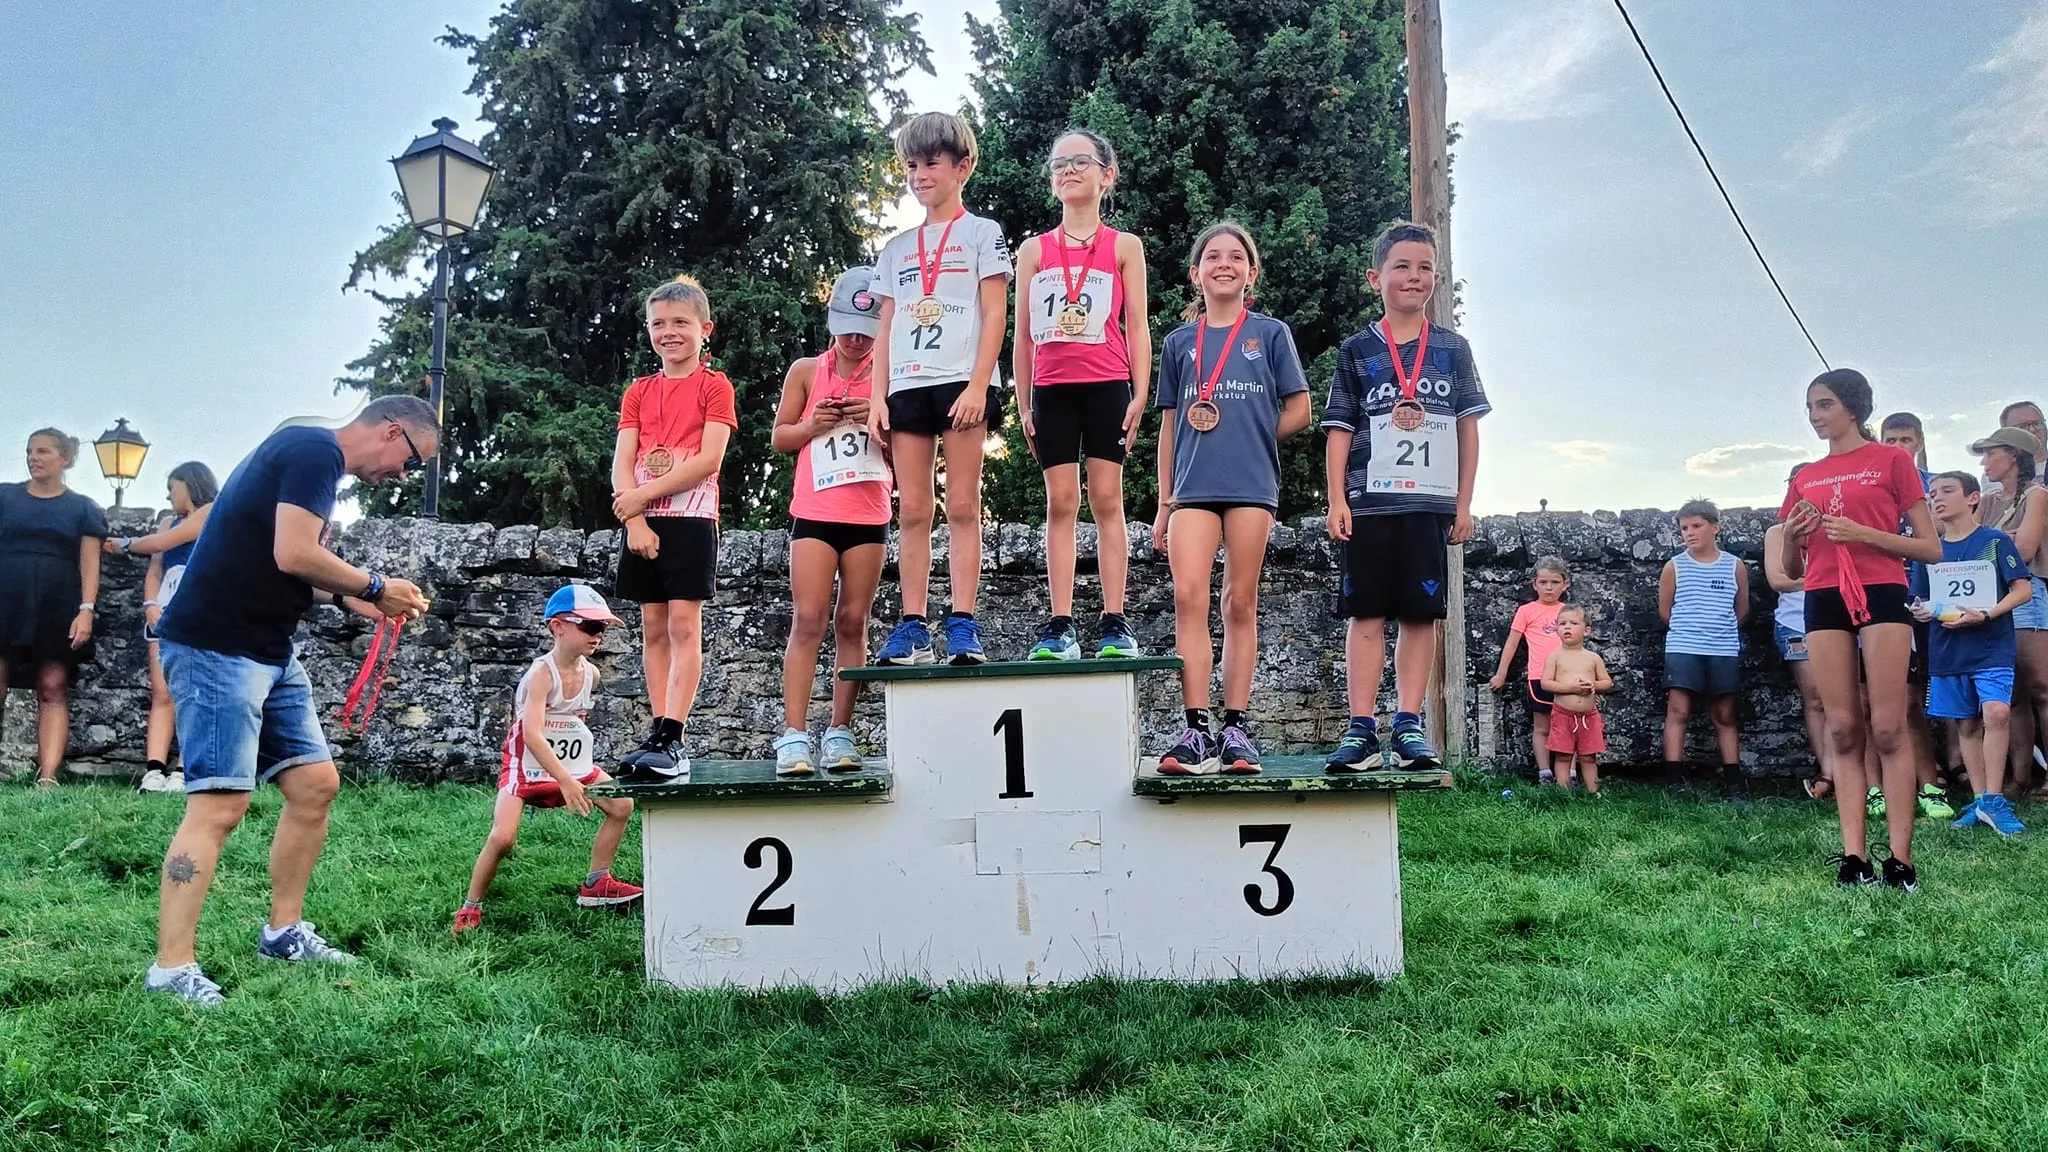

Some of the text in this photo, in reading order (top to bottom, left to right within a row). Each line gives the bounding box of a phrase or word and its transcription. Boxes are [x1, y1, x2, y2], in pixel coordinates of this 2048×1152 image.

[911, 324, 943, 350] 12
[1226, 380, 1264, 393] Martin
[825, 431, 869, 461] 137
[1396, 440, 1431, 467] 21
[1948, 579, 1976, 597] 29
[993, 709, 1034, 799] 1
[743, 836, 796, 927] 2
[1238, 823, 1296, 918] 3
